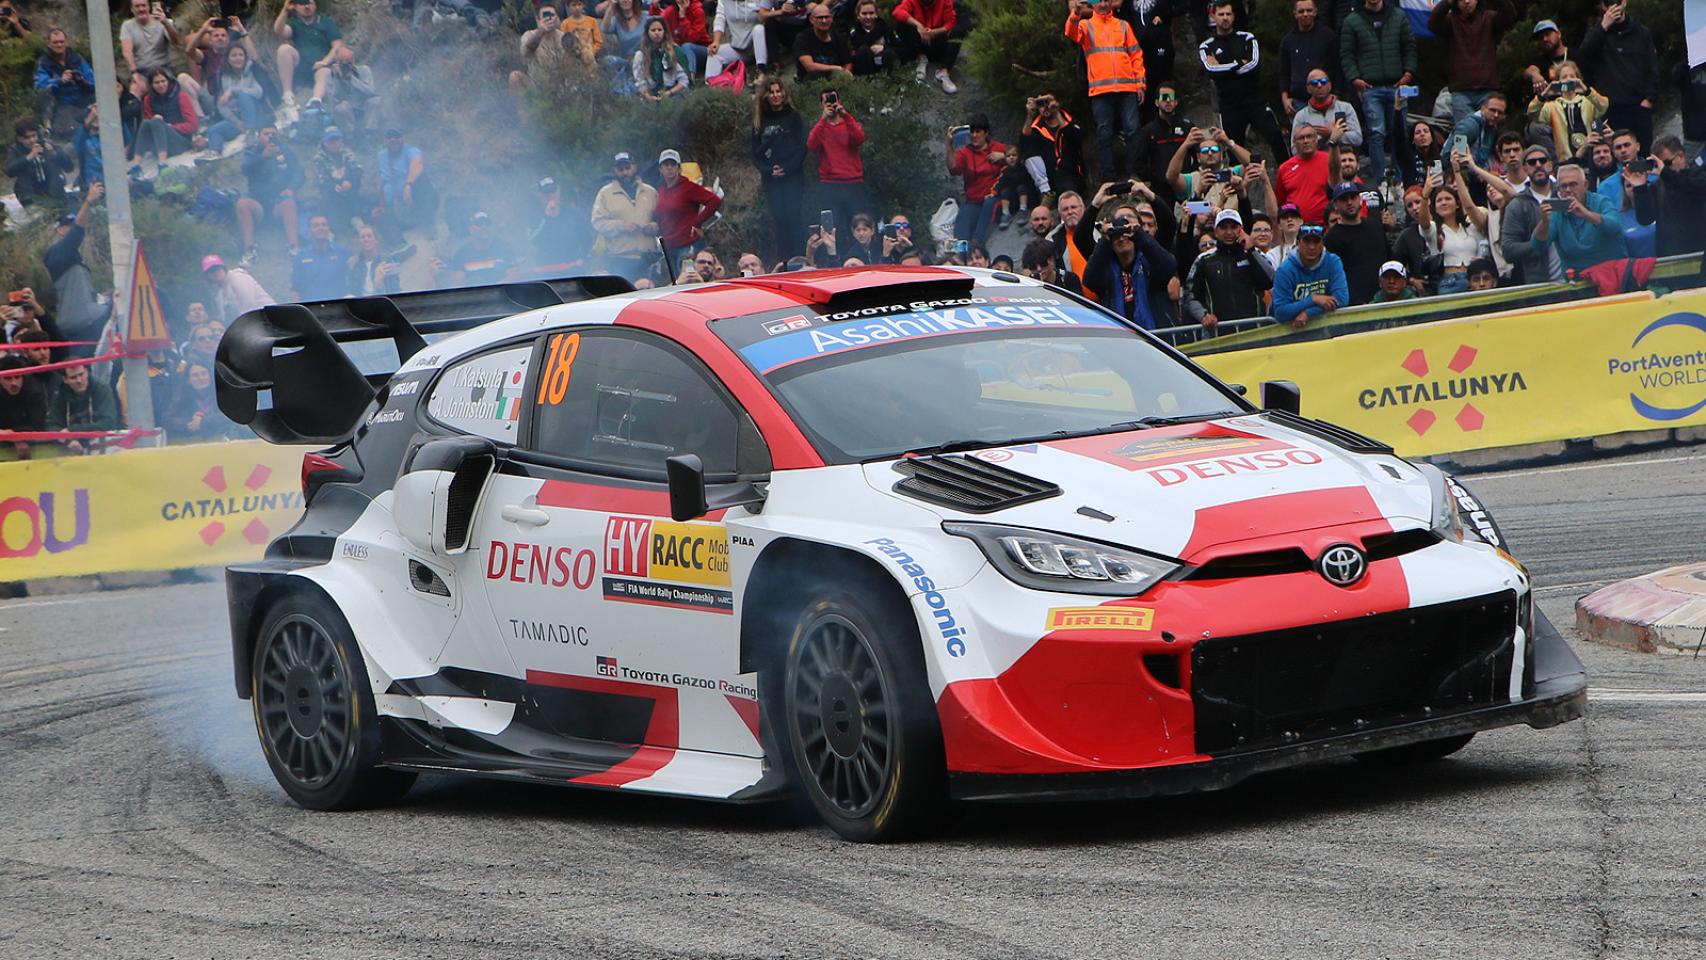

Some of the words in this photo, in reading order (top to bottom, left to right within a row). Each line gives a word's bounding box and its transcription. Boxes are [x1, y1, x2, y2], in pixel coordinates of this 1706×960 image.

[813, 303, 906, 322] TOYOTA
[909, 298, 987, 308] GAZOO
[991, 297, 1061, 306] Racing
[537, 332, 580, 405] 18
[1608, 350, 1706, 375] PortAvent
[1640, 368, 1706, 389] WORLD
[1359, 372, 1527, 410] CATALUNYA
[1147, 450, 1323, 487] DENSO
[606, 519, 649, 574] HY
[652, 533, 705, 570] RACC
[733, 535, 755, 547] PIAA
[487, 540, 596, 590] DENSO
[708, 556, 728, 572] Club
[628, 584, 638, 594] FIA
[639, 585, 656, 596] World
[657, 587, 672, 600] Rally
[673, 589, 714, 605] Championship
[864, 537, 967, 658] Panasonic
[510, 619, 589, 646] TAMADIC
[1053, 610, 1146, 626] PIRELLI
[597, 663, 617, 678] GR
[620, 667, 669, 684] TOYOTA
[672, 673, 716, 690] GAZOO
[719, 680, 758, 700] Racing
